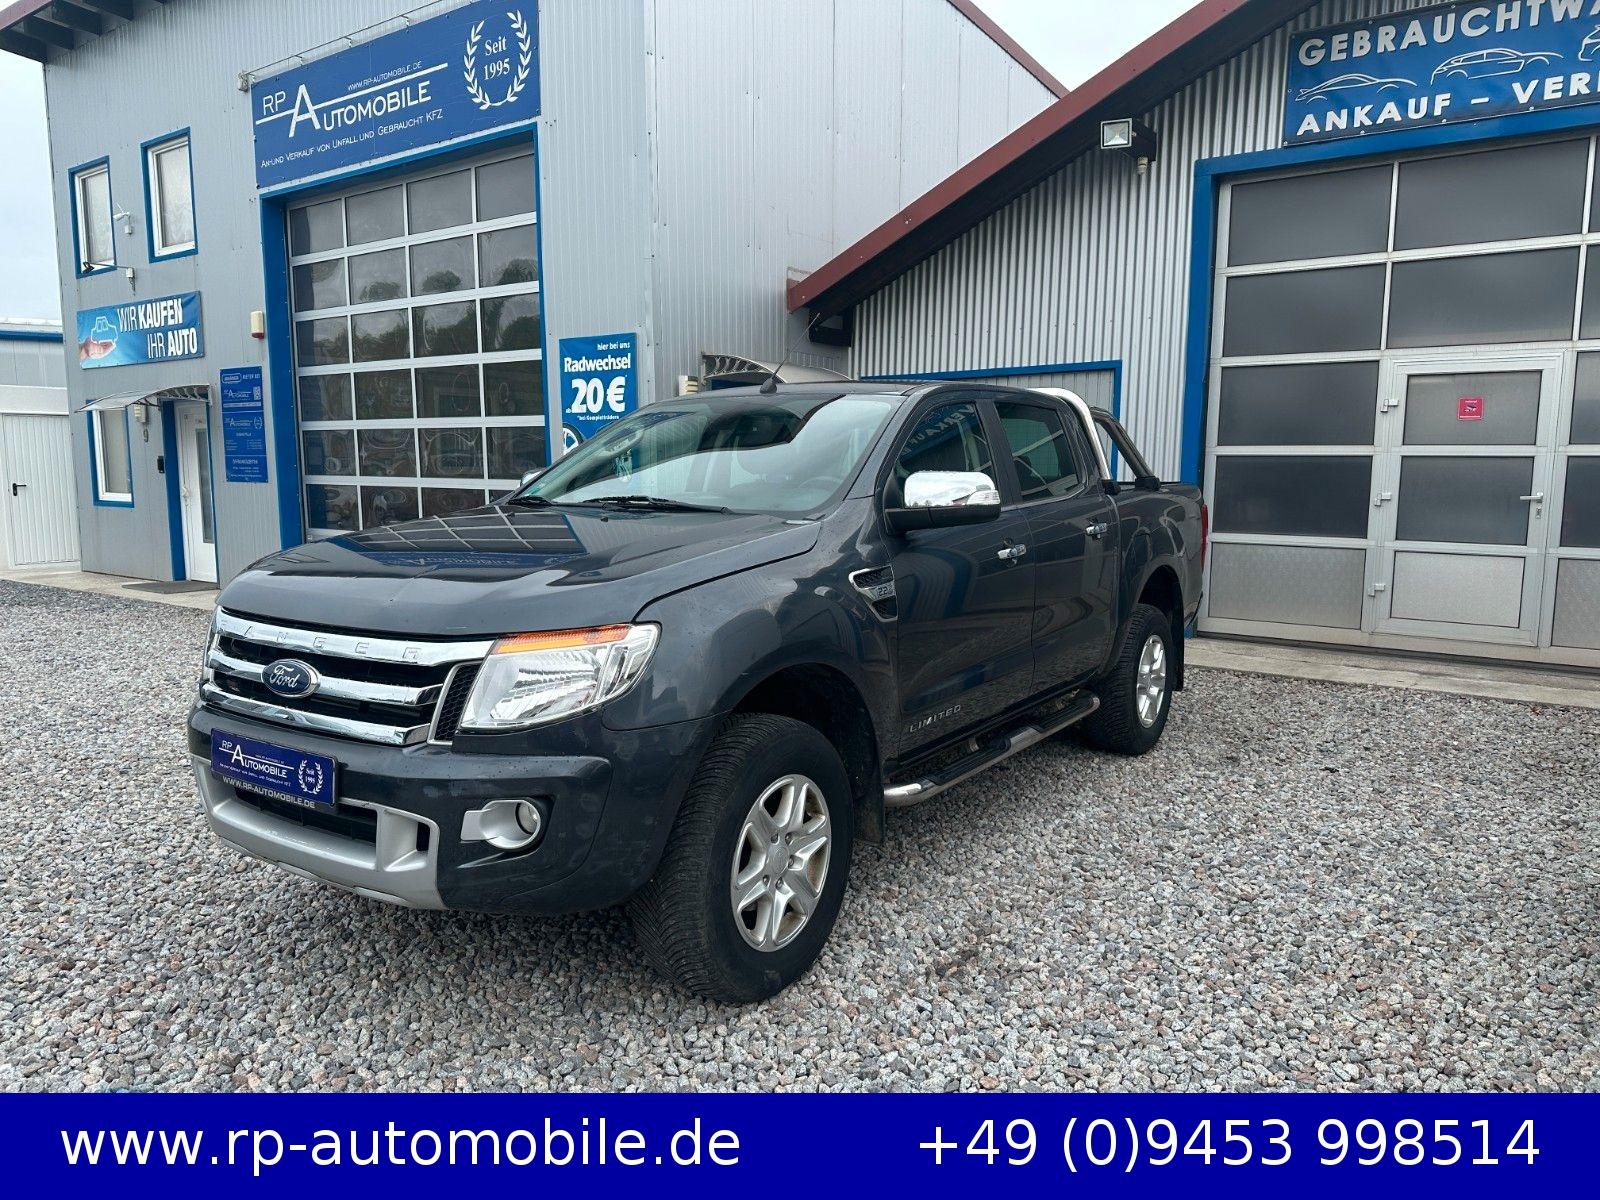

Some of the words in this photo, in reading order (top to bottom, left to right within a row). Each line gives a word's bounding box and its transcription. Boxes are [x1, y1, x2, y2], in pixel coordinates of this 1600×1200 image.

[484, 35, 507, 57] Seit
[1298, 0, 1600, 66] GEBRAUCHTW
[483, 58, 511, 81] 1995
[262, 91, 286, 116] RP
[288, 81, 432, 138] AUTOMOBILE
[1297, 93, 1451, 136] ANKAUF
[1512, 70, 1600, 104] VER
[359, 130, 375, 141] UND
[378, 116, 424, 136] GEBRAUCHT
[426, 108, 443, 122] KFZ
[117, 306, 138, 333] WIR
[138, 298, 183, 330] KAUFEN
[148, 333, 165, 359] IHR
[167, 328, 198, 356] AUTO
[597, 343, 608, 351] hier
[609, 342, 619, 350] bei
[564, 353, 632, 373] Radwechsel
[143, 429, 149, 443] 9
[270, 664, 301, 688] Ford
[909, 704, 962, 733] LIMITED
[221, 740, 233, 749] RP
[231, 744, 288, 779] AUTOMOBILE
[222, 775, 316, 809] WWW.RP-AUTOMOBILE.DE
